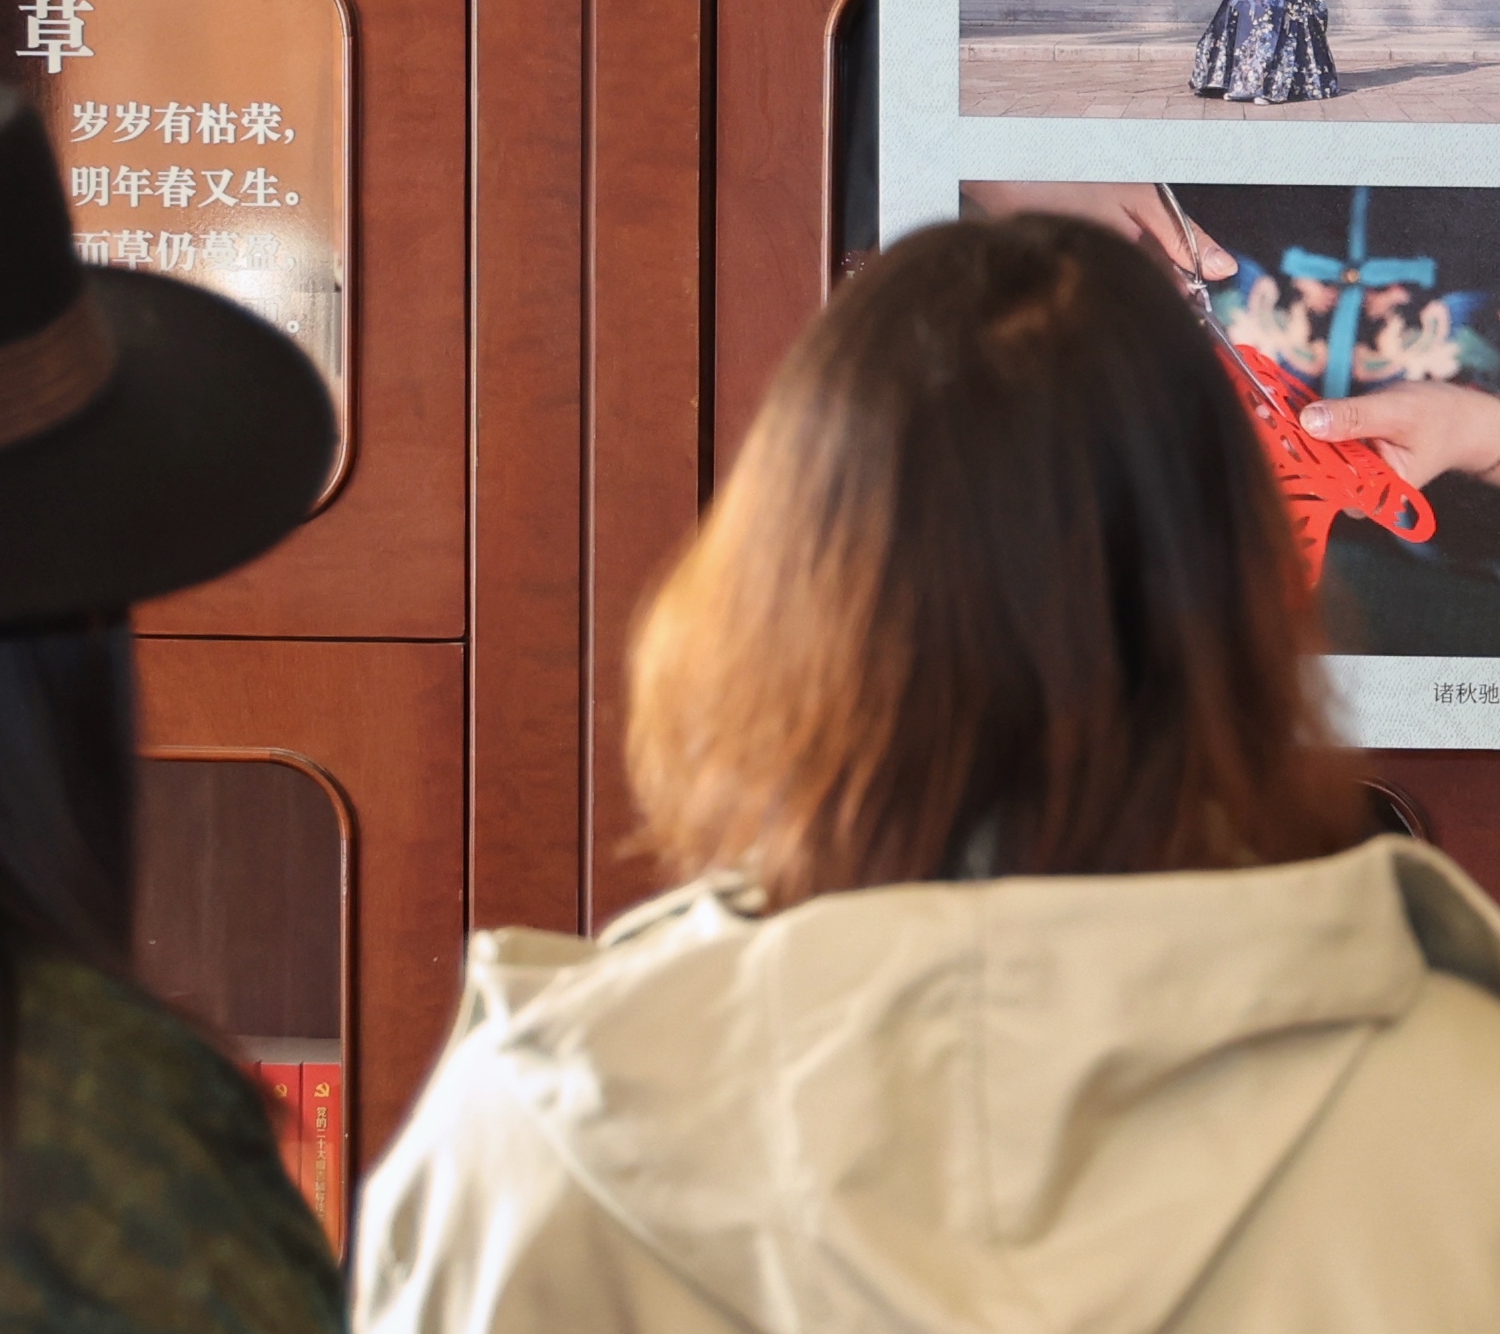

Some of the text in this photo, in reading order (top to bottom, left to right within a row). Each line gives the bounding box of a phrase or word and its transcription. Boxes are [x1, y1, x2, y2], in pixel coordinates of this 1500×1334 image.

[71, 101, 297, 145] 岁岁有枯荣，
[71, 165, 300, 208] 明年春又生。
